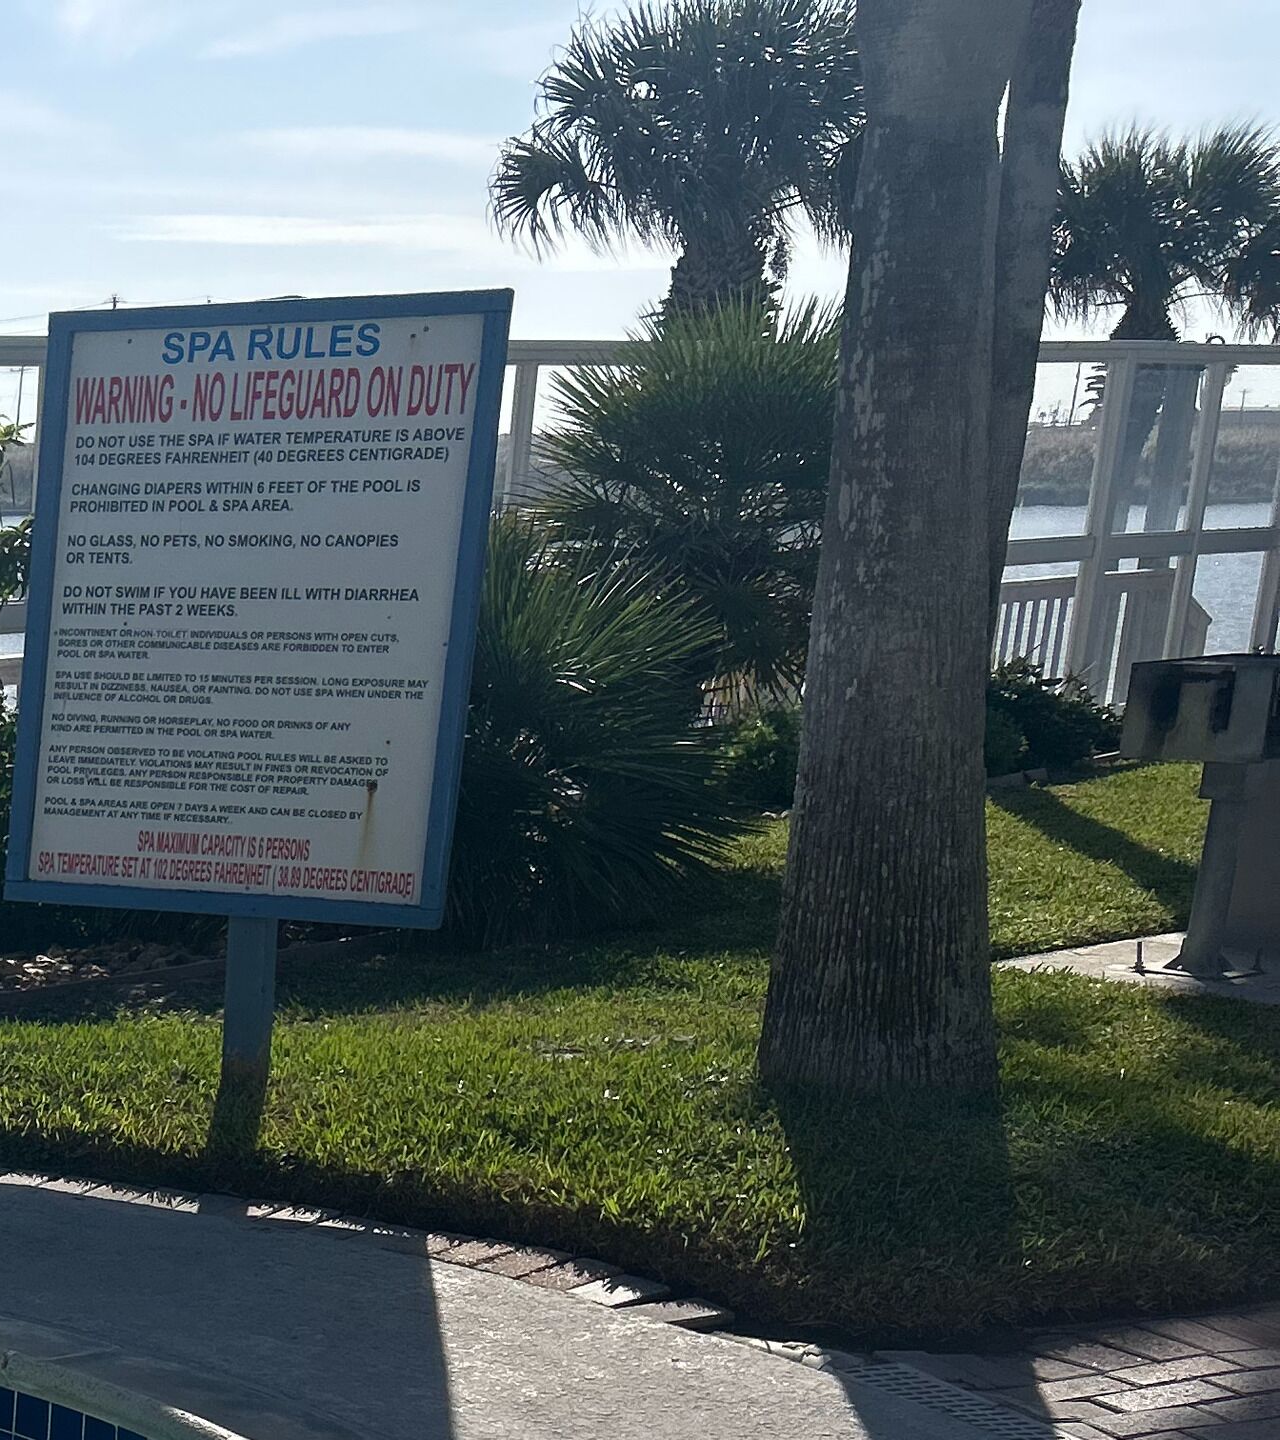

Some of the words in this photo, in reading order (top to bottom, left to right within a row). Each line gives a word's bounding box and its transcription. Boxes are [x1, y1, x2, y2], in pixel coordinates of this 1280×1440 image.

[161, 330, 237, 364] SPA
[247, 323, 382, 360] RULES
[73, 374, 175, 424] WARNING
[192, 372, 227, 421] NO
[229, 367, 362, 420] LIFEGUARD
[364, 365, 403, 417] ON
[406, 363, 474, 416] DUTY
[75, 436, 95, 448] DO
[97, 435, 125, 448] NOT
[128, 435, 155, 447] USE
[158, 434, 185, 446] THE
[187, 433, 215, 446] SPA
[217, 433, 230, 445] IF
[233, 432, 281, 445] WATER
[284, 429, 392, 444] TEMPERATURE
[395, 429, 409, 441] IS
[412, 427, 465, 441] ABOVE
[74, 453, 95, 465] 104
[98, 452, 161, 465] DEGREES
[164, 450, 250, 464] FAHRENHEIT
[253, 450, 273, 464] (40
[276, 448, 345, 462] DEGREES
[348, 446, 450, 461] CENTIGRADE)
[71, 483, 141, 495] CHANGING
[143, 482, 202, 494] DIAPERS
[205, 481, 253, 494] WITHIN
[256, 481, 265, 493] 6
[268, 481, 304, 493] FEET
[306, 480, 327, 492] OF
[329, 480, 359, 492] THE
[362, 479, 404, 492] POOL
[406, 479, 421, 491] IS
[70, 500, 148, 512] PROHIBITED
[151, 500, 165, 511] IN
[168, 499, 206, 511] POOL
[208, 499, 219, 511] &
[222, 499, 249, 511] SPA
[251, 499, 294, 511] AREA.
[67, 535, 86, 546] NO
[89, 535, 137, 546] GLASS,
[140, 535, 160, 546] NO
[163, 534, 201, 546] PETS,
[204, 535, 225, 546] NO
[227, 534, 297, 546] SMOKING,
[300, 535, 321, 546] NO
[324, 534, 399, 547] CANOPIES
[66, 552, 85, 563] OR
[87, 552, 133, 563] TENTS.
[63, 586, 82, 597] DO
[85, 586, 112, 597] NOT
[115, 586, 150, 598] SWIM
[153, 586, 165, 598] IF
[168, 587, 196, 598] YOU
[200, 587, 236, 599] HAVE
[239, 587, 277, 599] BEEN
[280, 588, 302, 599] ILL
[304, 588, 340, 599] WITH
[344, 588, 419, 600] DIARRHEA
[61, 603, 106, 614] WITHIN
[109, 603, 135, 614] THE
[138, 603, 173, 615] PAST
[175, 604, 183, 615] 2
[185, 604, 238, 616] WEEKS.
[57, 638, 88, 650] SORES
[89, 639, 103, 650] OR
[104, 639, 136, 651] OTHER
[137, 640, 211, 649] COMMUNICABLE
[212, 642, 259, 650] DISEASES
[260, 642, 281, 650] ARE
[282, 643, 339, 652] FORBIDDEN
[340, 644, 355, 652] TO
[356, 644, 389, 653] ENTER
[72, 724, 92, 732] ARE
[93, 725, 144, 734] PERMITTED
[156, 727, 174, 735] THE
[176, 728, 201, 736] POOL
[203, 728, 217, 736] OR
[219, 729, 238, 737] SPA
[48, 745, 67, 756] ANY
[68, 745, 105, 758] PERSON
[106, 746, 156, 759] OBSERVED
[156, 748, 170, 760] TO
[171, 749, 185, 760] BE
[186, 750, 235, 762] VIOLATING
[236, 752, 263, 763] POOL
[264, 753, 297, 765] RULES
[297, 754, 322, 766] WILL
[323, 755, 337, 763] BE
[338, 756, 373, 765] ASKED
[374, 757, 388, 765] TO
[46, 775, 60, 783] OR
[61, 776, 84, 785] LOSS
[85, 775, 108, 786] WILL
[109, 778, 122, 786] BE
[123, 779, 186, 789] RESPONSIBLE
[188, 782, 208, 790] FOR
[208, 783, 228, 791] THE
[229, 784, 256, 792] COST
[257, 785, 271, 793] OF
[44, 796, 69, 808] POOL
[69, 798, 77, 809] &
[78, 798, 96, 810] SPA
[96, 799, 128, 811] AREAS
[128, 801, 148, 812] ARE
[149, 801, 175, 813] OPEN
[177, 802, 183, 814] 7
[183, 803, 209, 815] DAYS
[209, 804, 218, 812] A
[218, 805, 246, 813] WEEK
[247, 806, 268, 814] AND
[269, 807, 290, 816] CAN
[292, 808, 305, 817] BE
[307, 809, 347, 818] CLOSED
[348, 811, 363, 819] BY
[137, 830, 156, 852] SPA
[155, 831, 200, 854] MAXIMUM
[200, 834, 246, 857] CAPACITY
[246, 836, 257, 857] IS
[257, 837, 265, 858] 6
[264, 837, 311, 860] PERSONS
[38, 851, 55, 873] SPA
[56, 852, 120, 876] TEMPERATURE
[120, 856, 139, 877] SET
[139, 857, 152, 877] AT
[152, 858, 168, 879] 102
[168, 859, 213, 882] DEGREES
[213, 861, 272, 885] FAHRENHEIT
[277, 865, 302, 888] 38.89
[302, 867, 348, 890] DEGREES
